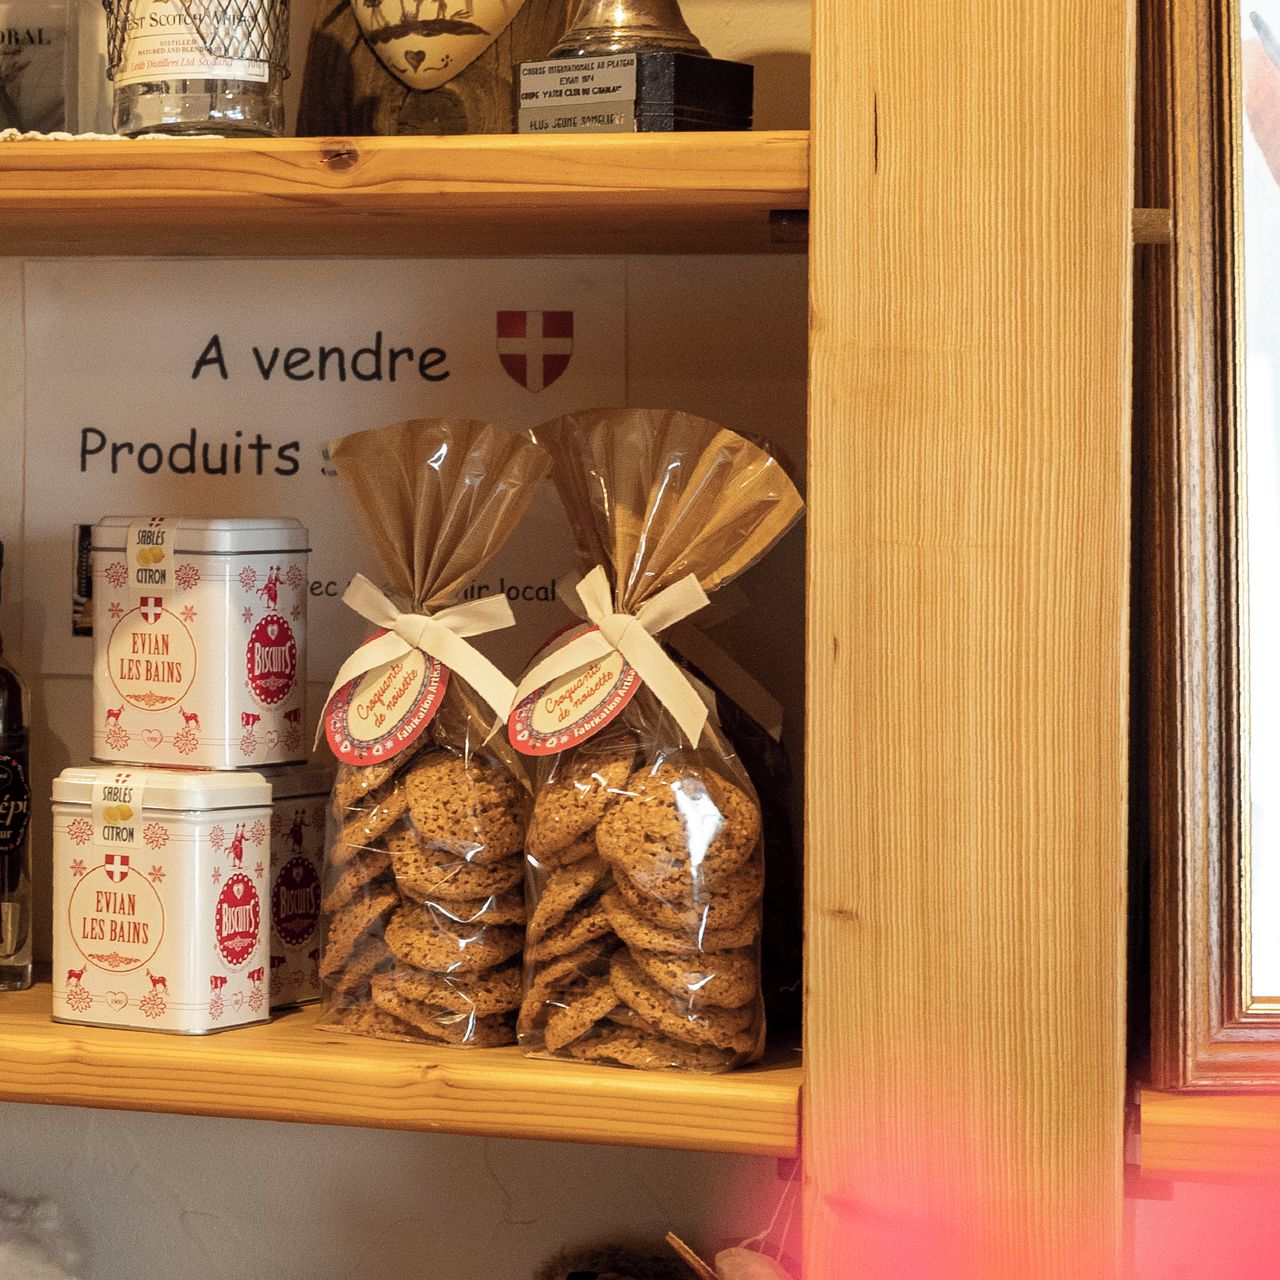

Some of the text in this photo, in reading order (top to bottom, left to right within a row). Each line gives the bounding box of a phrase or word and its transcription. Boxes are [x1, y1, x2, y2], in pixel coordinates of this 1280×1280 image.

[192, 330, 451, 382] A vendre
[80, 427, 300, 476] Produits
[136, 568, 166, 585] CITRON
[500, 578, 556, 602] local
[132, 632, 170, 656] EVIAN
[254, 641, 292, 676] BISCUITS
[120, 658, 182, 684] LES BAINS
[374, 669, 418, 728] de noisette
[558, 672, 614, 722] de noisette
[396, 694, 434, 740] Fabrication
[574, 696, 622, 737] Fabrication
[102, 825, 134, 843] CITRON
[96, 890, 136, 916] EVIAN
[222, 899, 256, 938] BISCUITS
[82, 916, 150, 946] LES BAINS
